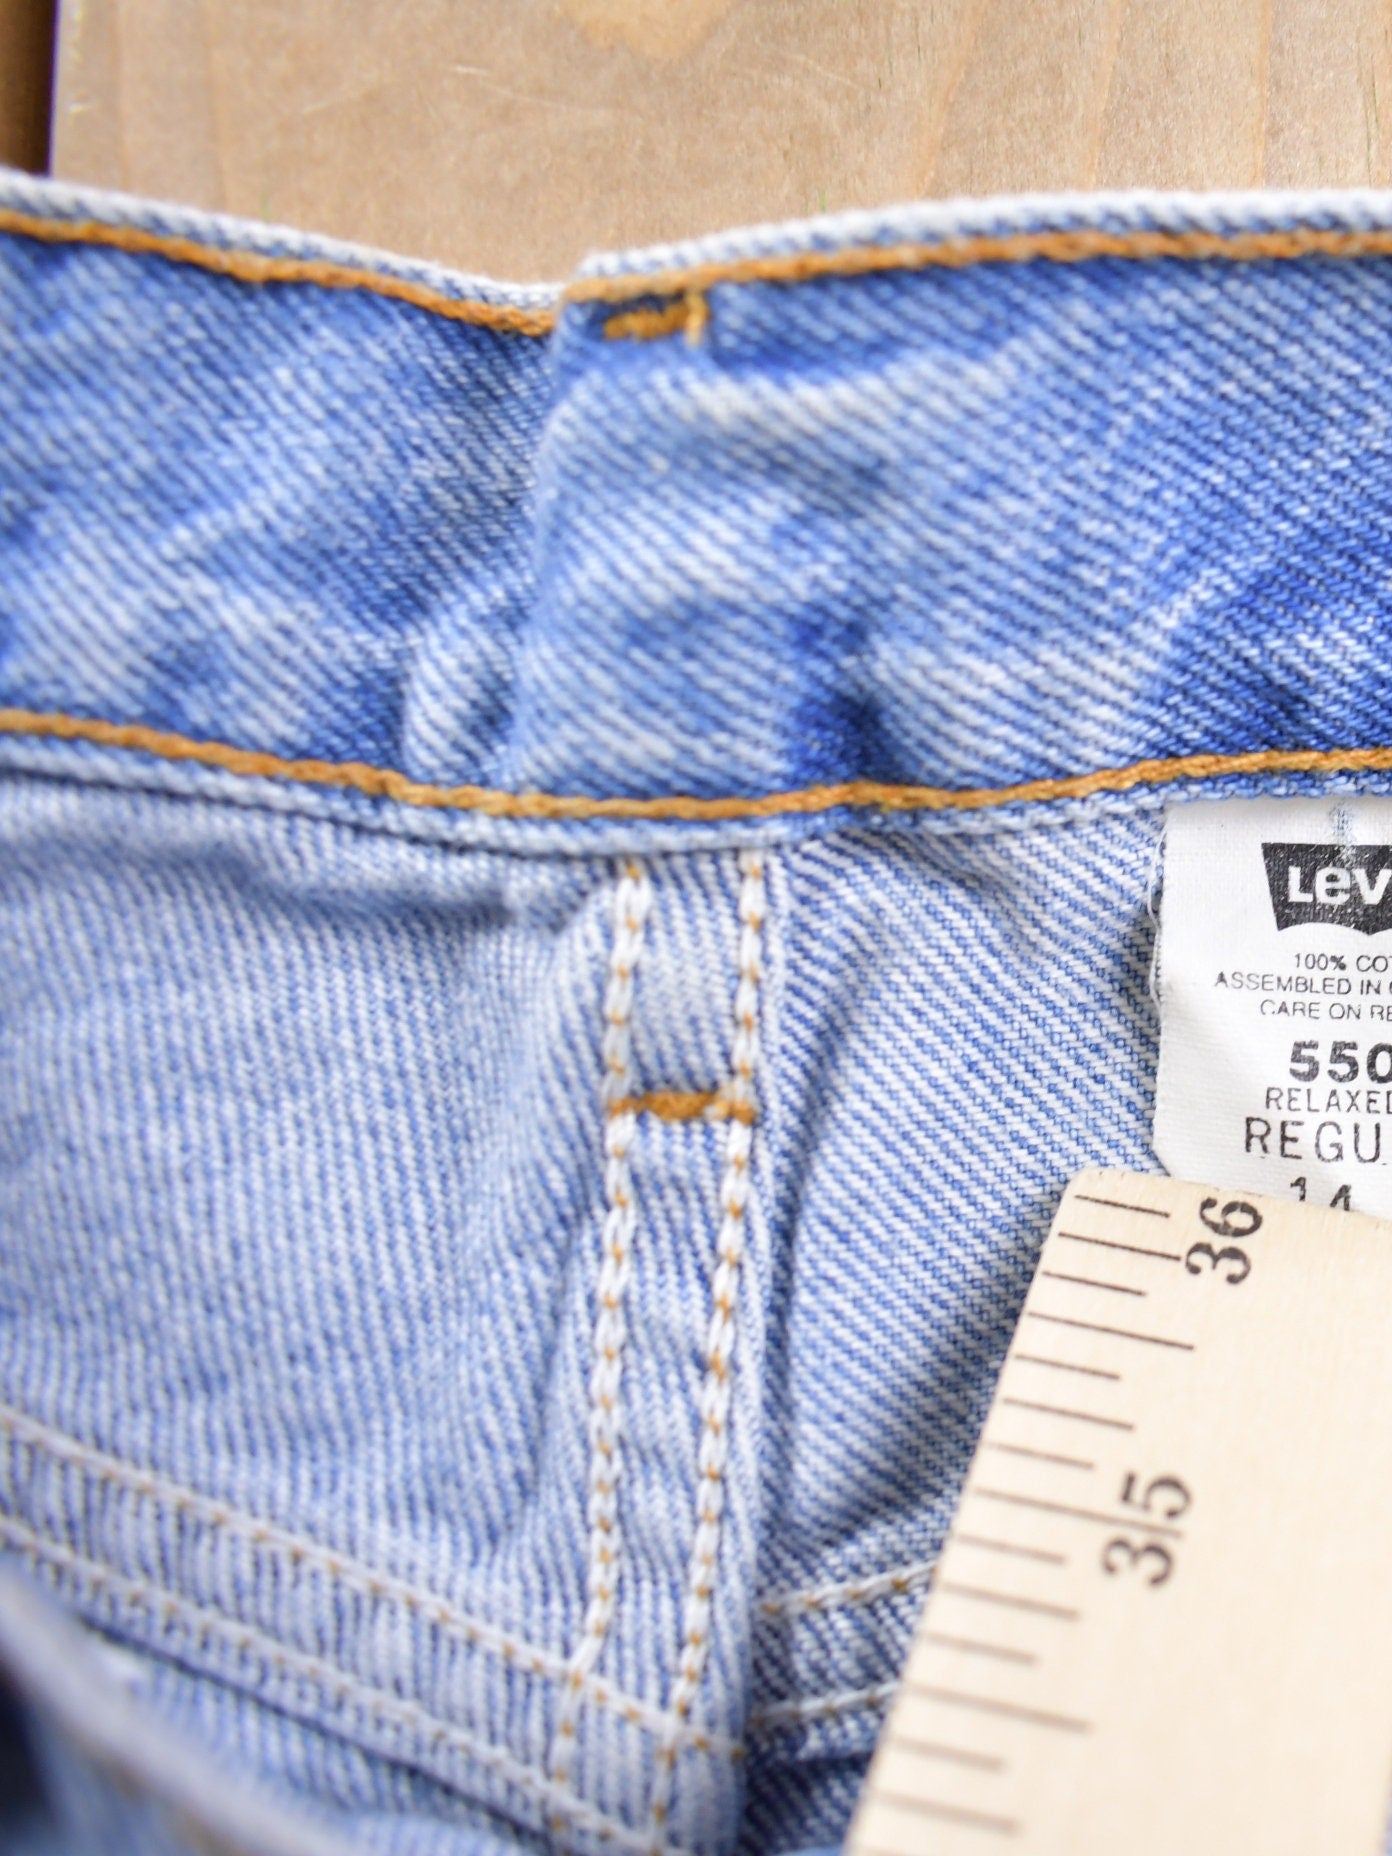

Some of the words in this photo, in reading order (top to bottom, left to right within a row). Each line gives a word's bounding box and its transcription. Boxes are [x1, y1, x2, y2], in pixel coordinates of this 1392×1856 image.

[1294, 953, 1347, 972] 100%
[1214, 971, 1351, 996] ASSEMBLED
[1360, 979, 1381, 996] IN
[1260, 999, 1320, 1020] CARE
[1329, 1003, 1362, 1020] ON
[1185, 1197, 1263, 1285] 36
[1101, 1471, 1194, 1588] 35
